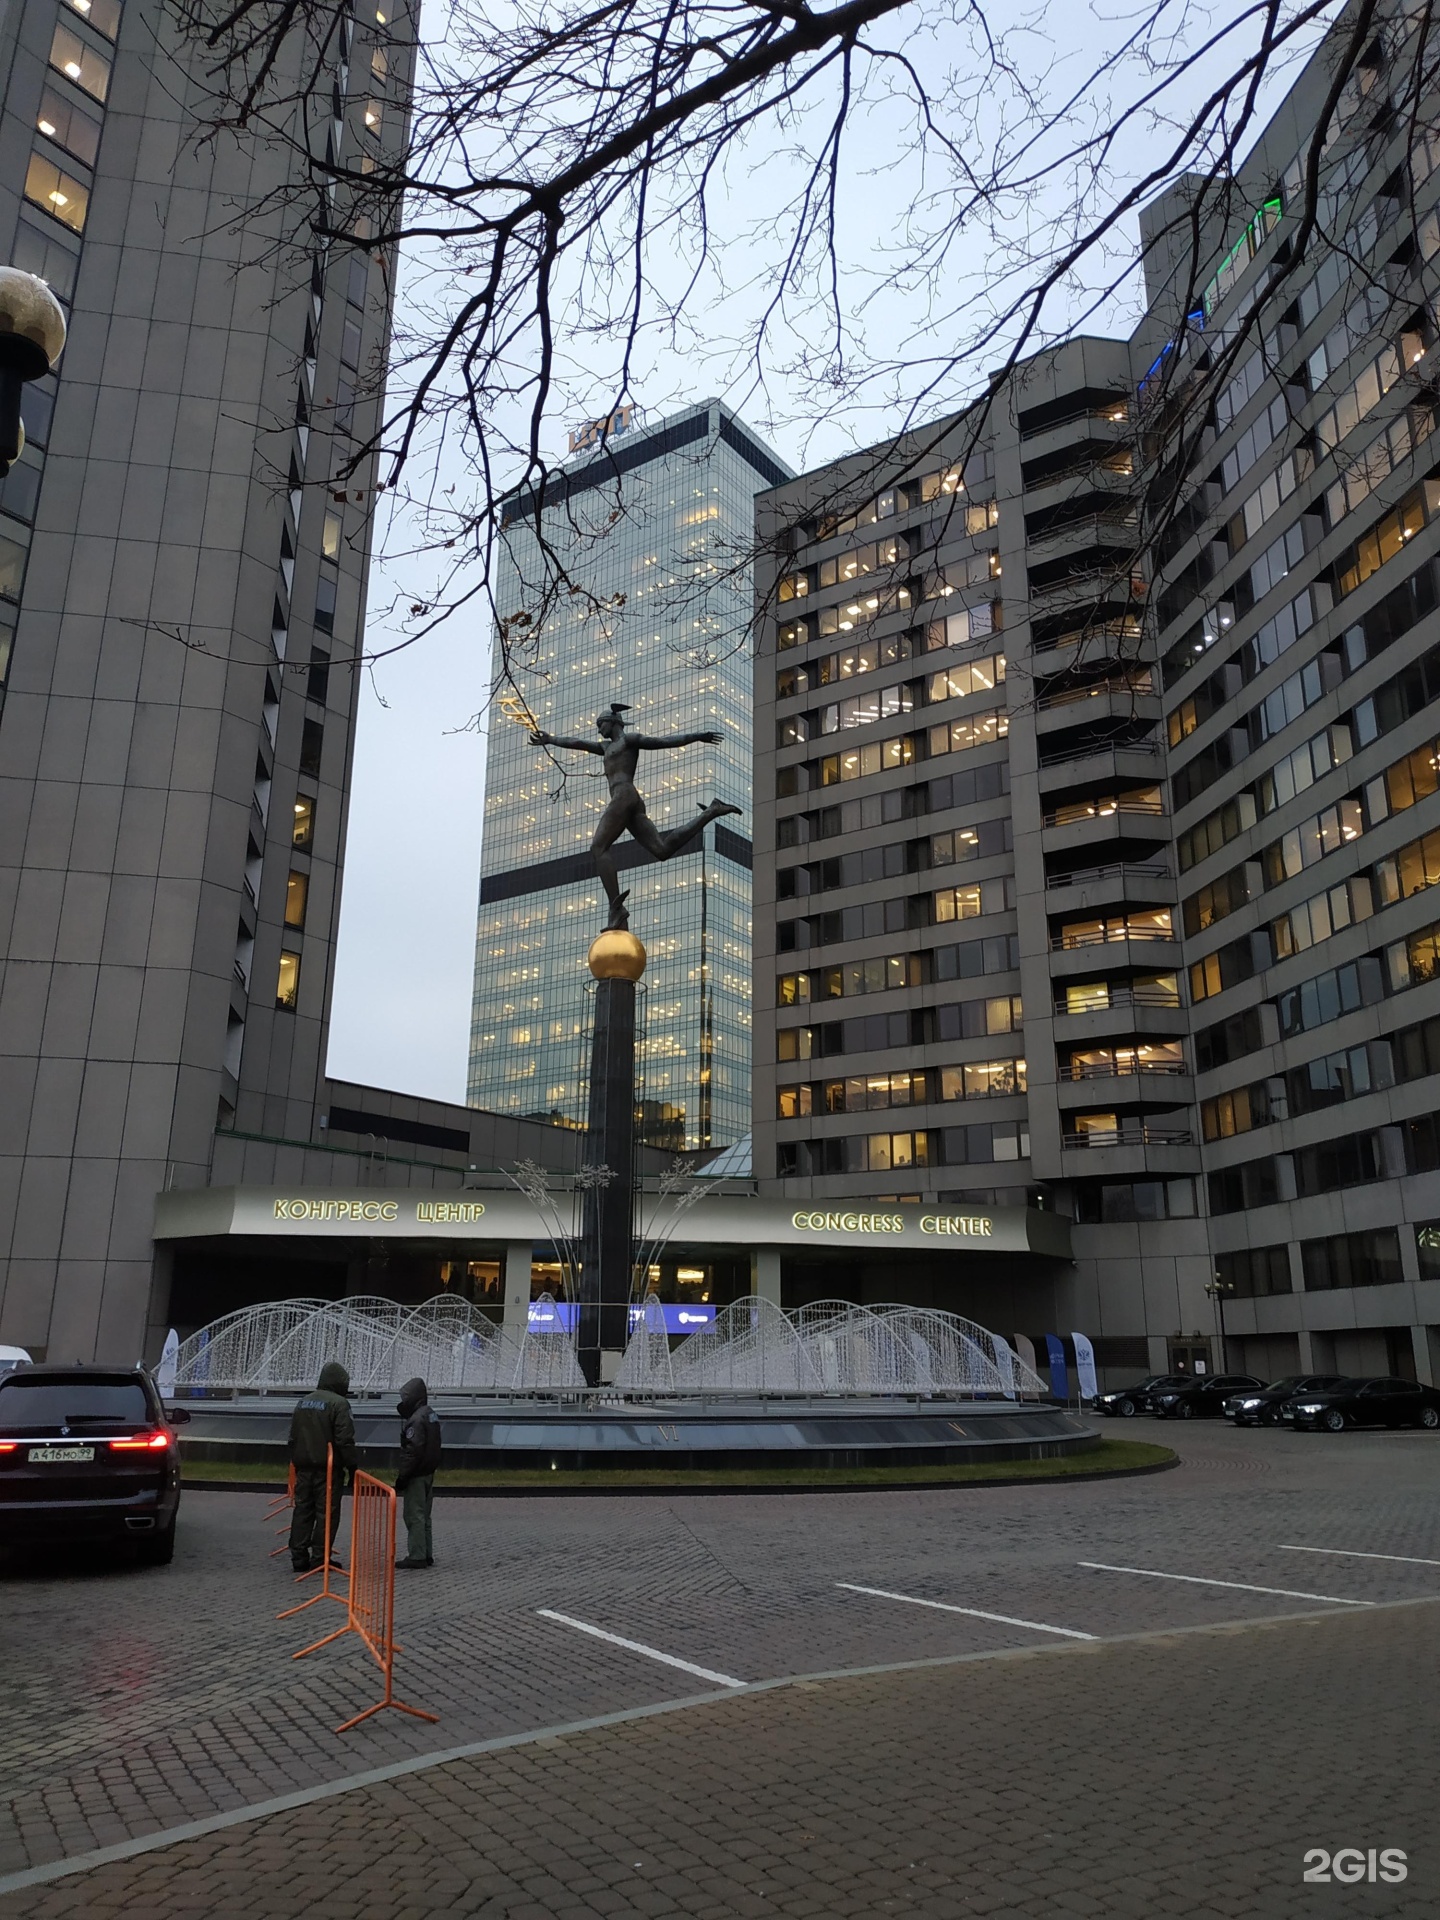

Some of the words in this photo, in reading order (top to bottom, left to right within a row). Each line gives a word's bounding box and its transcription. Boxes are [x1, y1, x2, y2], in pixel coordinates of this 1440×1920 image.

[274, 1199, 398, 1221] КОНГРЕСС
[416, 1202, 485, 1224] ЦЕНТР
[792, 1211, 904, 1233] CONGRESS
[920, 1215, 993, 1237] CENTER
